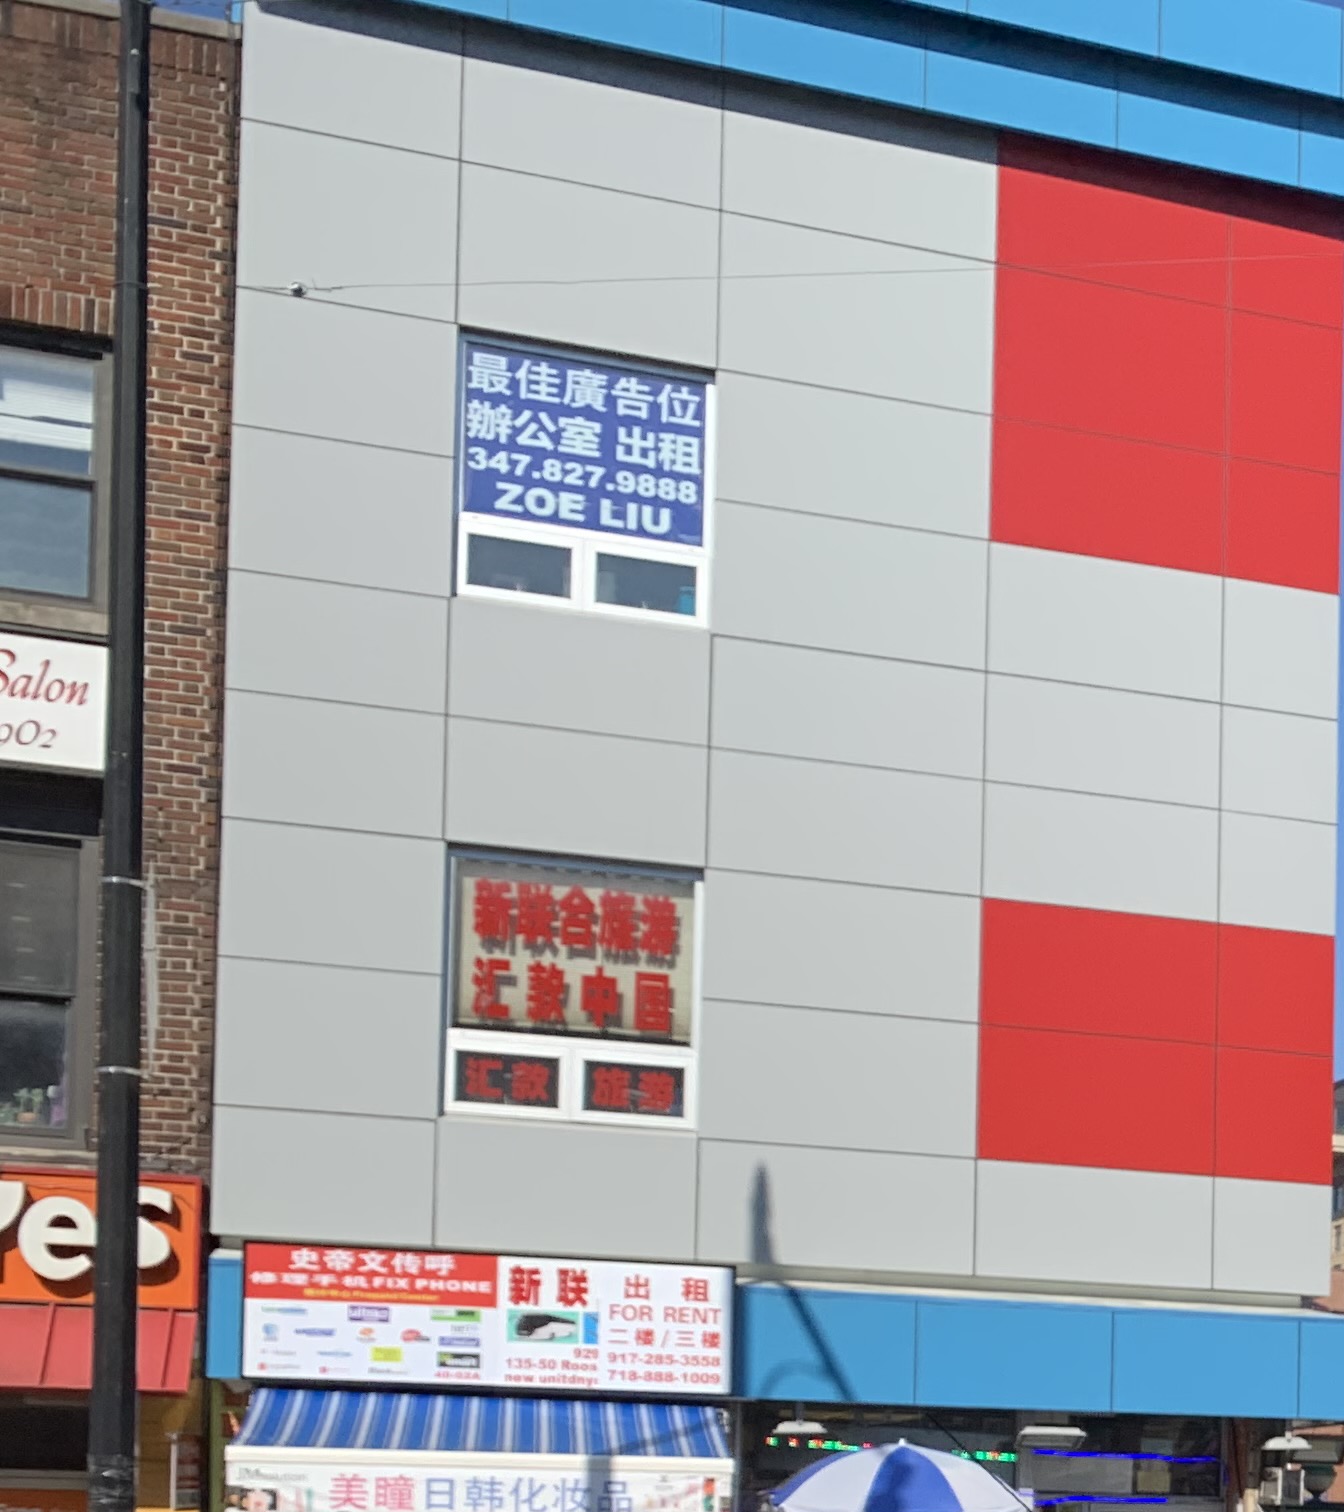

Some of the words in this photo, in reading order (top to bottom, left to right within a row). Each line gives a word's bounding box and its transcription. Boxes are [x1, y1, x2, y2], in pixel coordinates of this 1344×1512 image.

[467, 352, 702, 427] 最佳廣告位
[467, 399, 602, 458] 辦公室
[616, 426, 702, 475] 出租
[467, 447, 699, 504] 347.827.9888
[494, 481, 586, 522] ZOE
[600, 498, 671, 534] LIU
[373, 1275, 409, 1291] FIX
[415, 1278, 492, 1293] PHONE
[624, 1274, 710, 1302] 出租
[608, 1303, 653, 1321] FOR
[663, 1306, 722, 1324] RENT
[505, 1357, 556, 1371] 135-50
[607, 1352, 721, 1367] 917-285-3558
[607, 1369, 721, 1384] 718-888-1009
